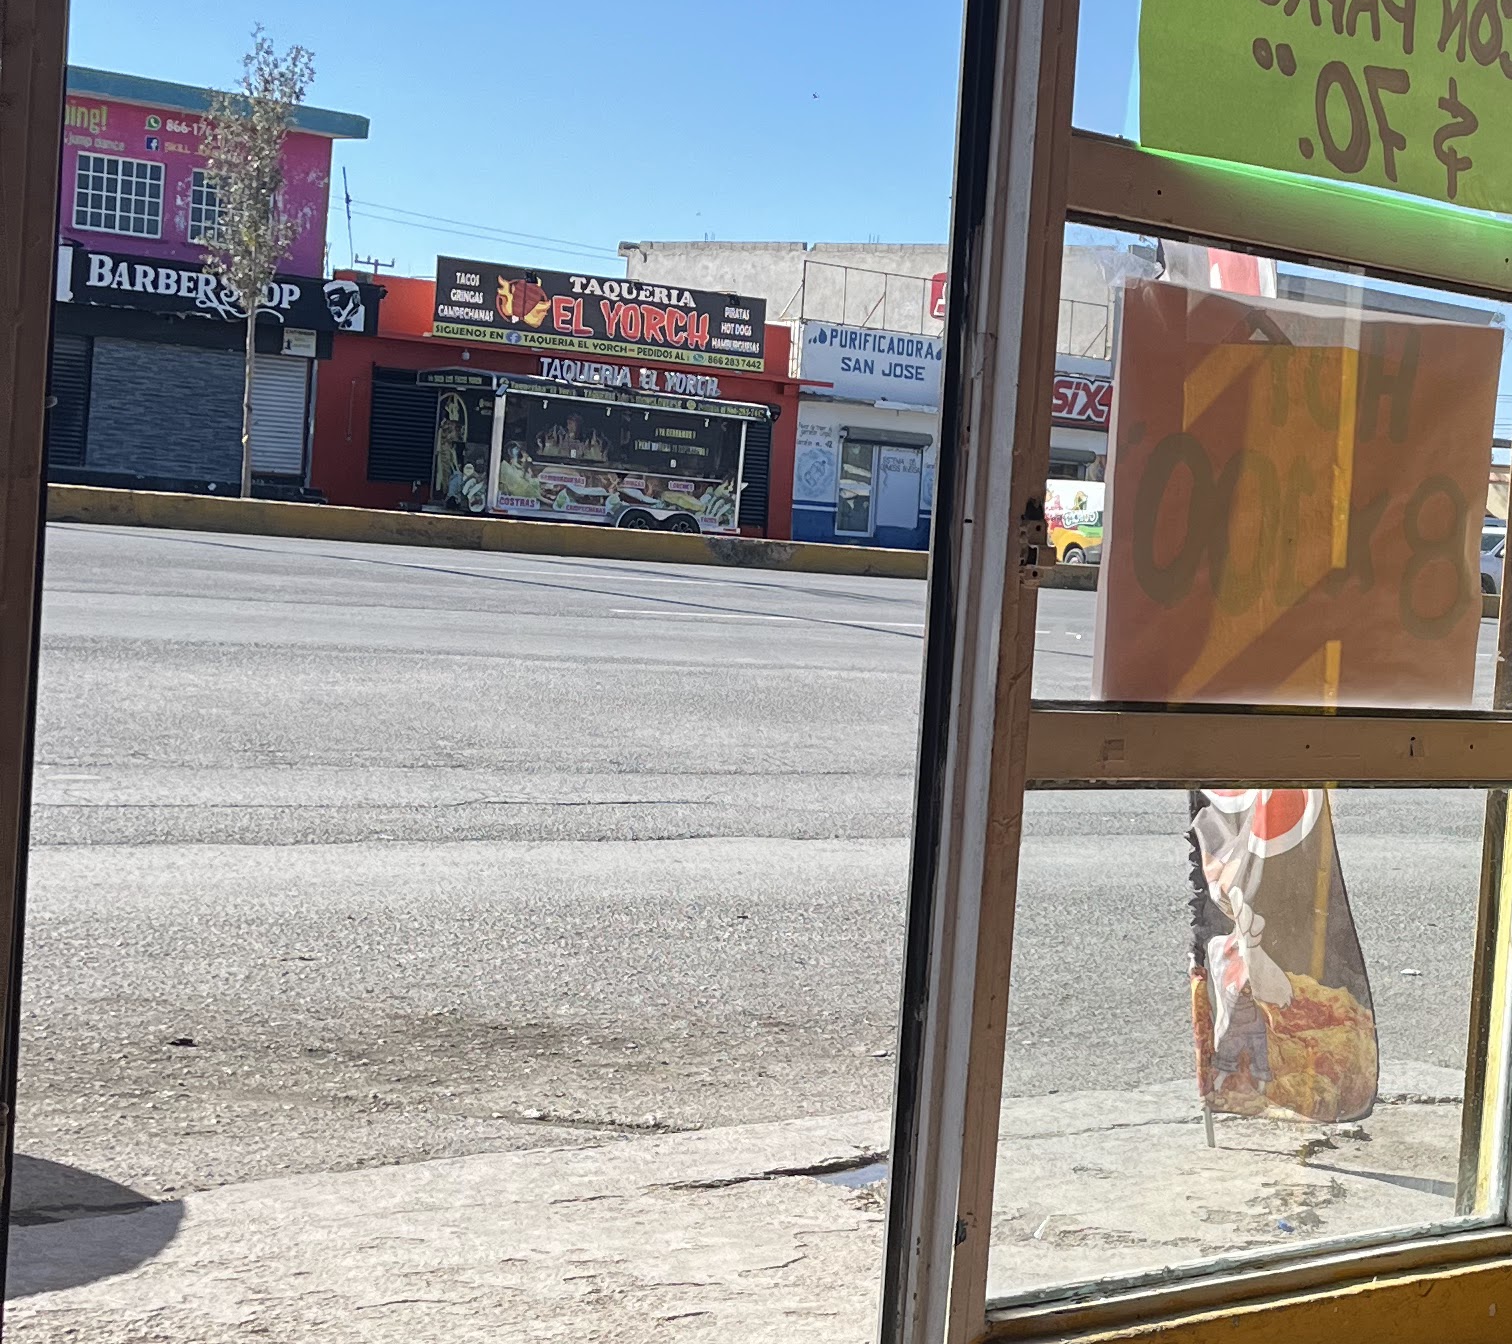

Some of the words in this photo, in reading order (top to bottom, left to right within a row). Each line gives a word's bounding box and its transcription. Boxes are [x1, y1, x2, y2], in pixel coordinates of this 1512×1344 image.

[455, 272, 481, 287] TACOS
[450, 288, 484, 304] GRINGAS
[569, 275, 697, 308] TAQUERIA
[438, 304, 494, 323] CAMPECHANAS
[552, 294, 594, 337] EL
[600, 299, 710, 351] YORCH
[724, 307, 750, 321] PIRATAS
[721, 322, 734, 335] HOT
[735, 323, 752, 337] DOGS
[435, 324, 487, 338] SIGUENOS
[489, 330, 504, 340] EN
[523, 334, 575, 348] TAQUERIA
[578, 340, 589, 349] EL
[592, 342, 628, 354] YORCH
[636, 347, 673, 359] PEDIDOS
[674, 351, 686, 361] AL
[708, 356, 724, 366] 866
[741, 358, 762, 370] 7442
[829, 328, 939, 361] PURIFICADORA
[540, 357, 632, 388] TAQUERIA
[640, 367, 660, 391] EL
[665, 371, 721, 397] YORCH
[840, 356, 875, 375] SAN
[882, 361, 926, 381] JOSE
[500, 497, 536, 508] COSTRAS
